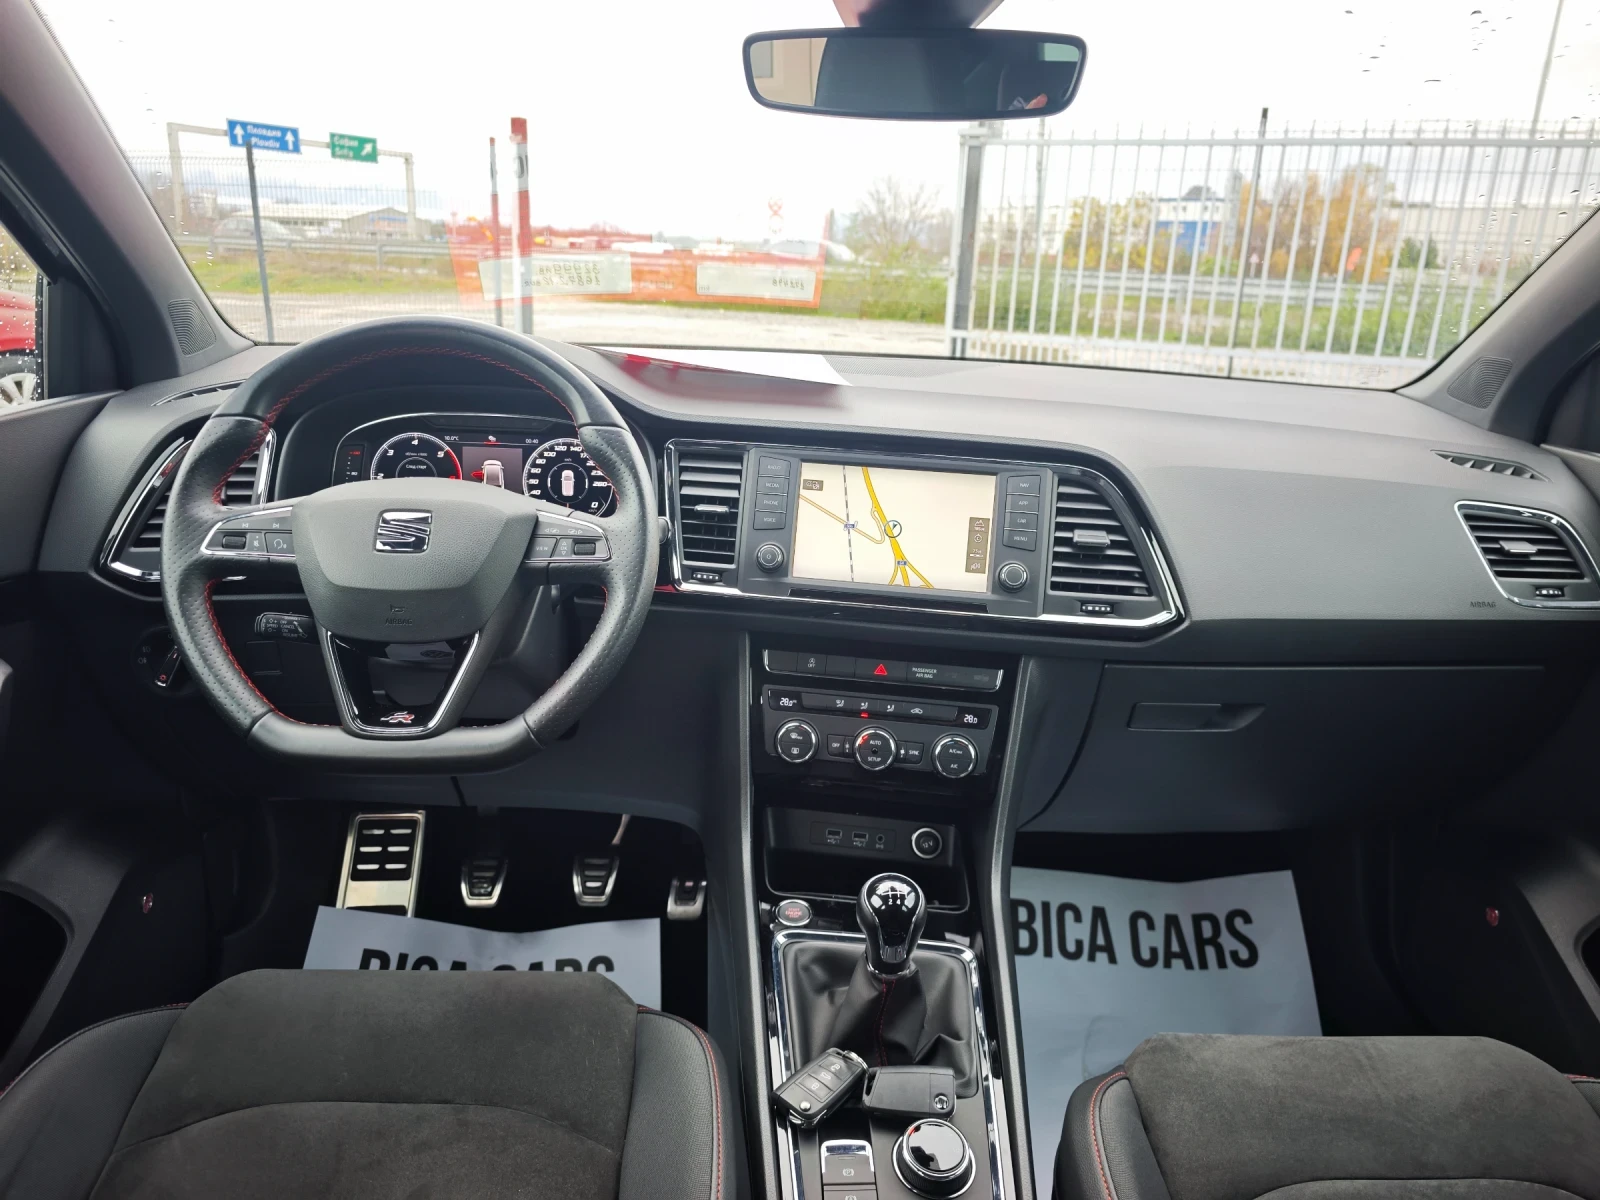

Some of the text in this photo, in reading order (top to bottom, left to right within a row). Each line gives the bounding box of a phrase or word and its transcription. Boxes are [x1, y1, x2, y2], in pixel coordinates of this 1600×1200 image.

[251, 137, 281, 149] Plovdiv
[386, 618, 413, 626] AIRBAG
[1010, 897, 1259, 970] BICA CARS
